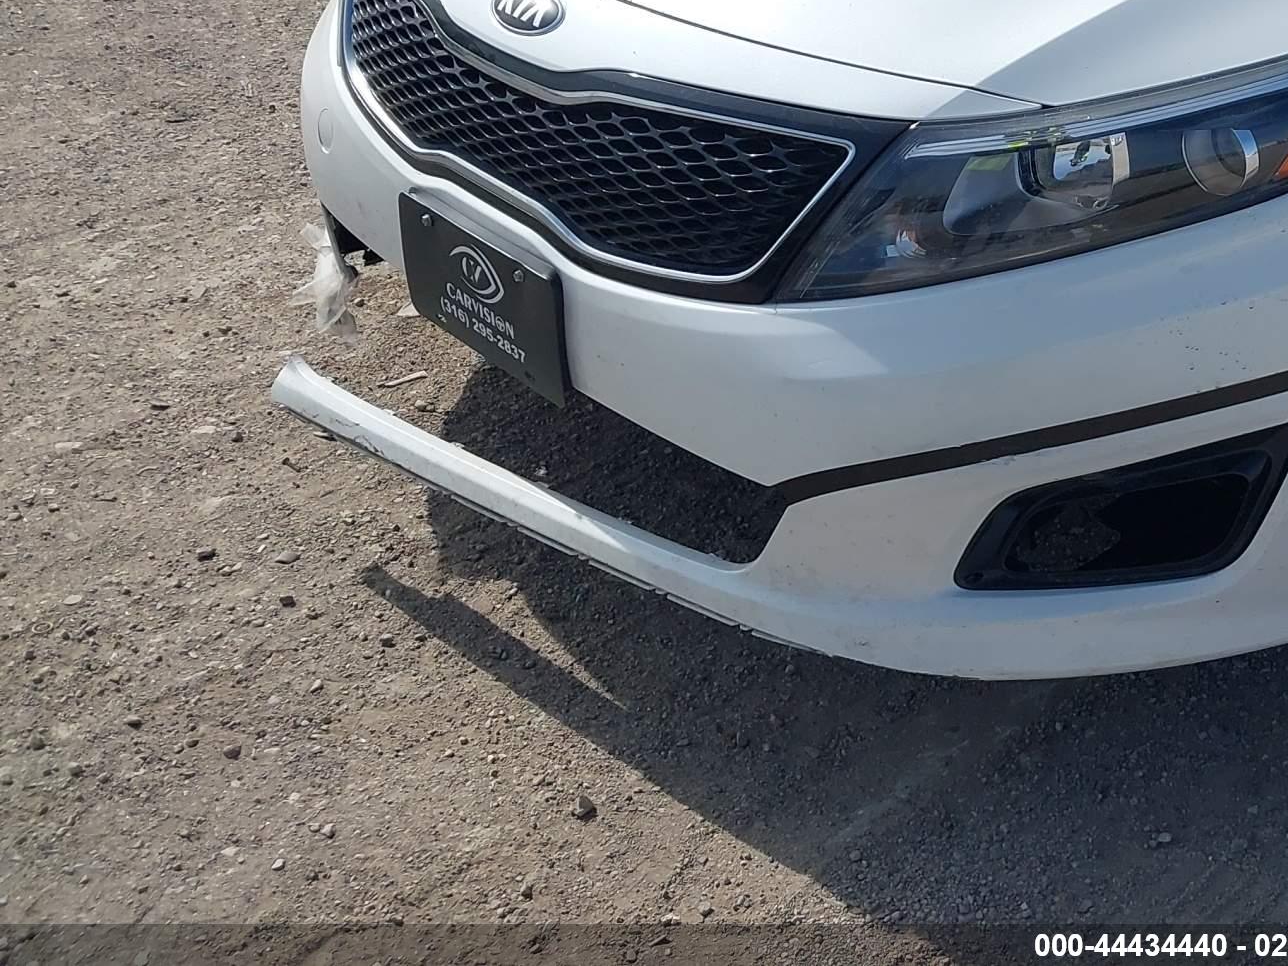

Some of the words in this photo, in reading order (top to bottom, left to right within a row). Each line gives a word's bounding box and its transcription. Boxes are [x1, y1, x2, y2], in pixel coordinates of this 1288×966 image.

[440, 296, 470, 329] (316)
[471, 318, 526, 363] 295-2837
[446, 282, 515, 340] CARVISION
